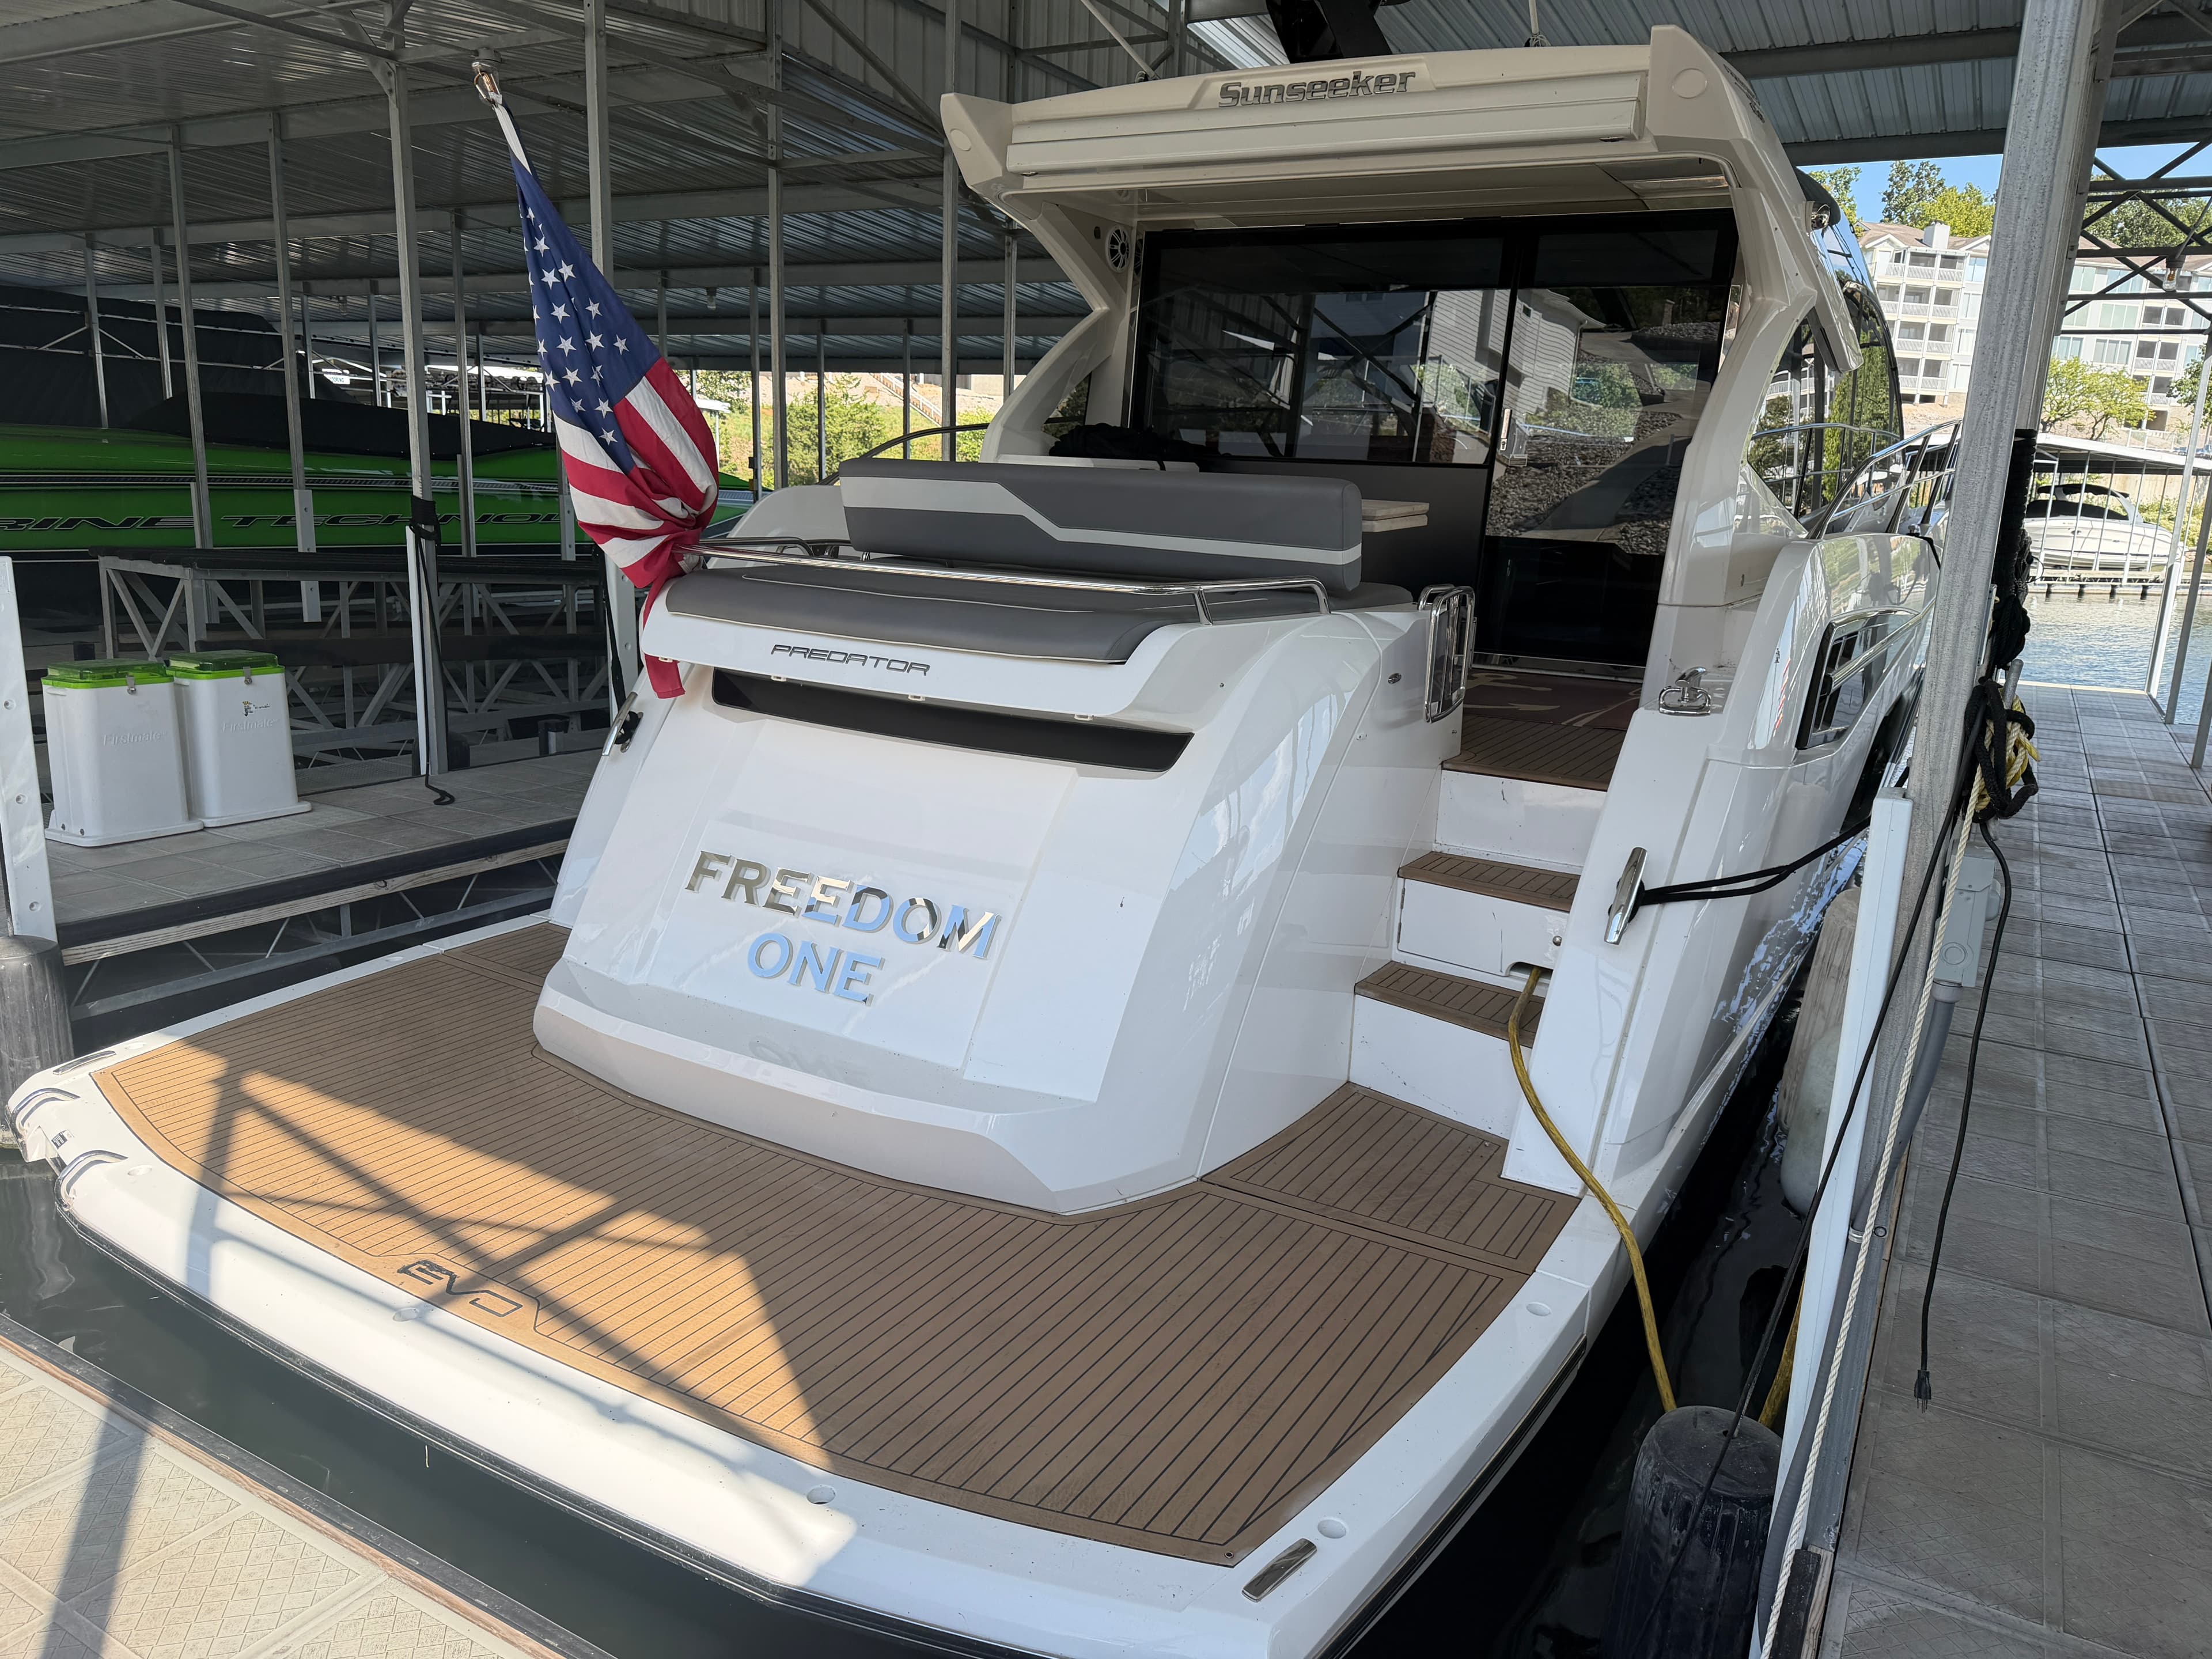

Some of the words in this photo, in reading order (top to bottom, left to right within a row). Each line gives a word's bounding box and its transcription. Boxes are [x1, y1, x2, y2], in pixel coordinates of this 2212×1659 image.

[1218, 70, 1416, 108] Sunseeker
[771, 644, 931, 676] PREDATOR
[685, 850, 1001, 959] FREEDOM
[748, 933, 885, 1006] ONE
[397, 1259, 523, 1317] EVO
